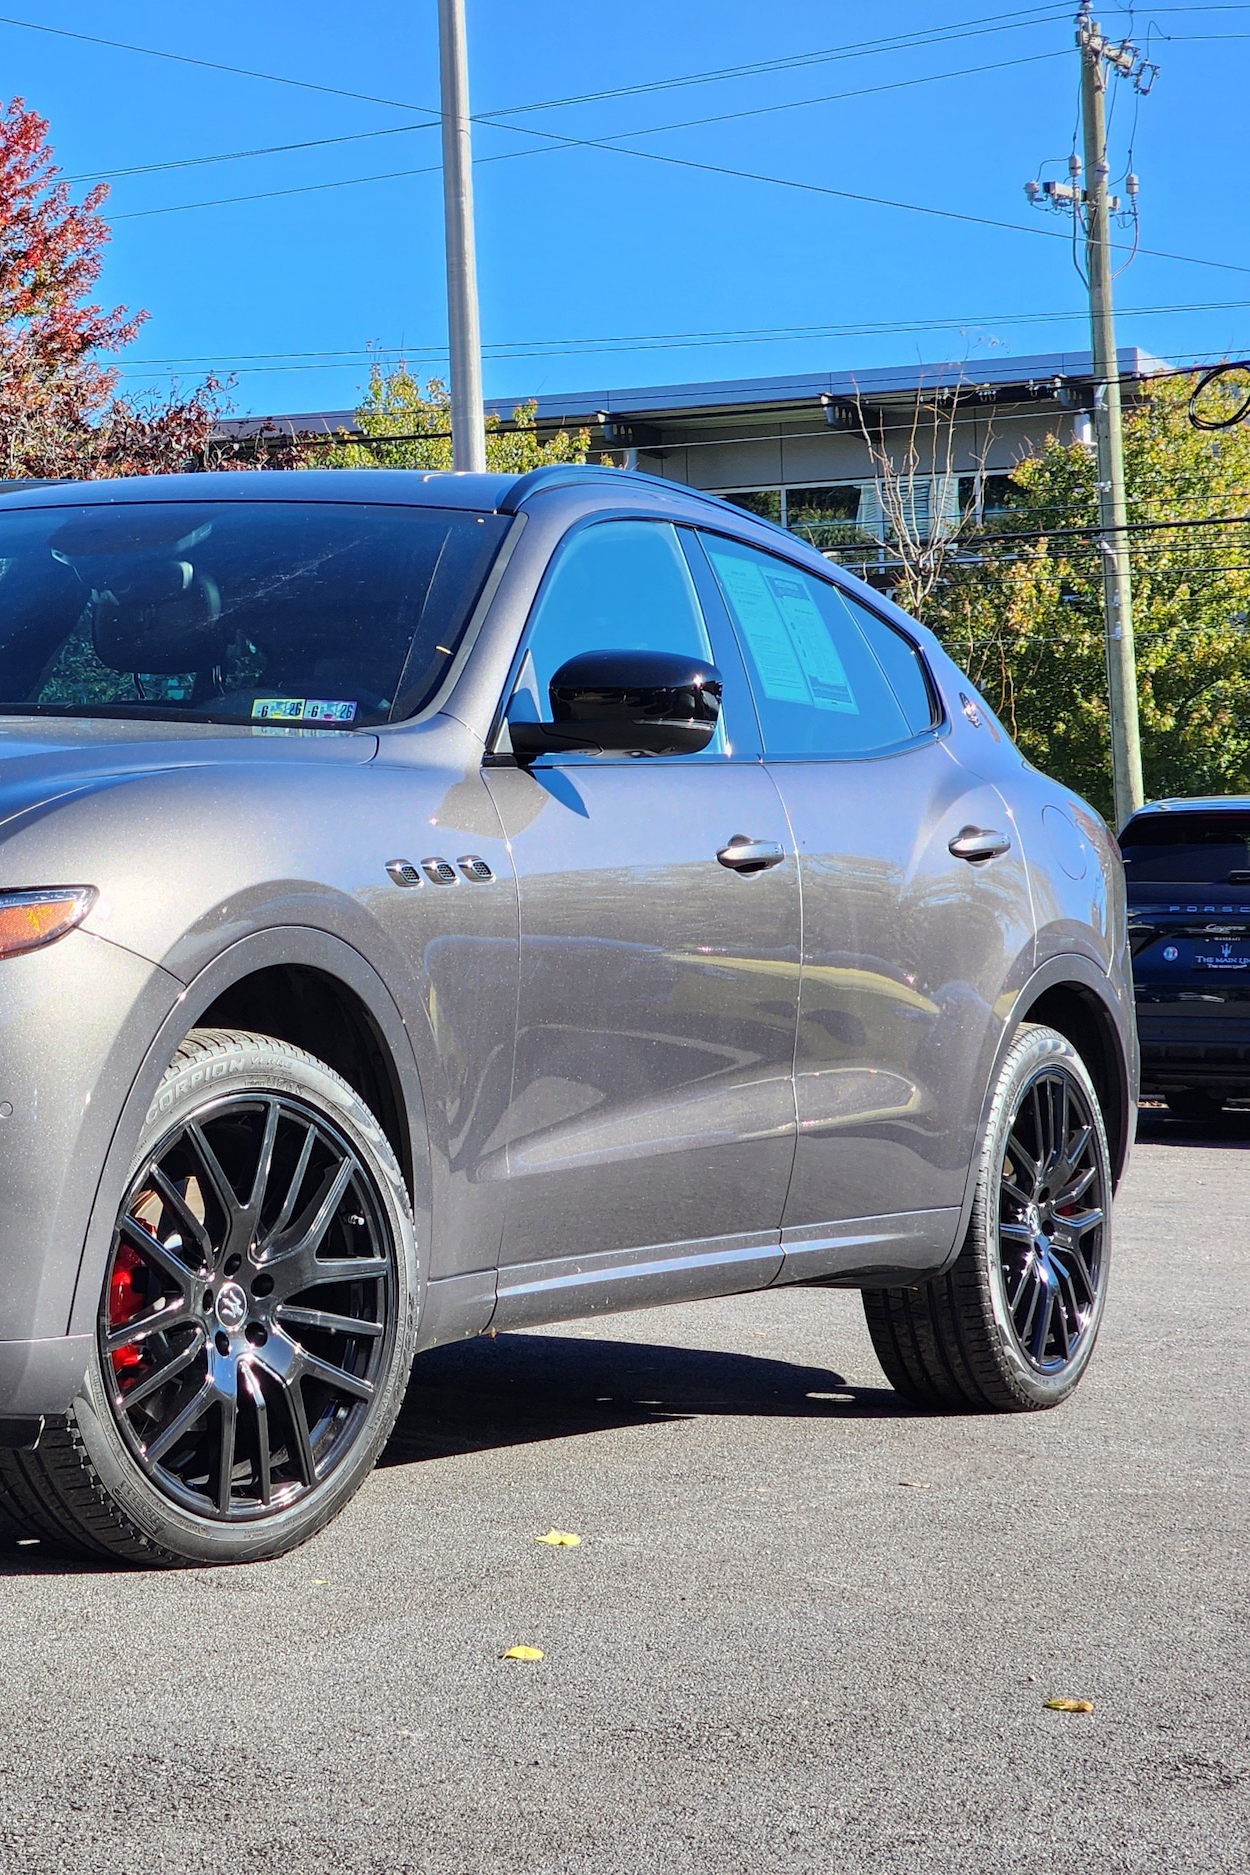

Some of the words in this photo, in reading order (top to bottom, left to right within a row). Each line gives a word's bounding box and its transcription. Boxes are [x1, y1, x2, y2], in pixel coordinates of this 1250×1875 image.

[289, 702, 302, 716] 26
[340, 704, 353, 718] 26
[146, 1058, 245, 1125] CORPION
